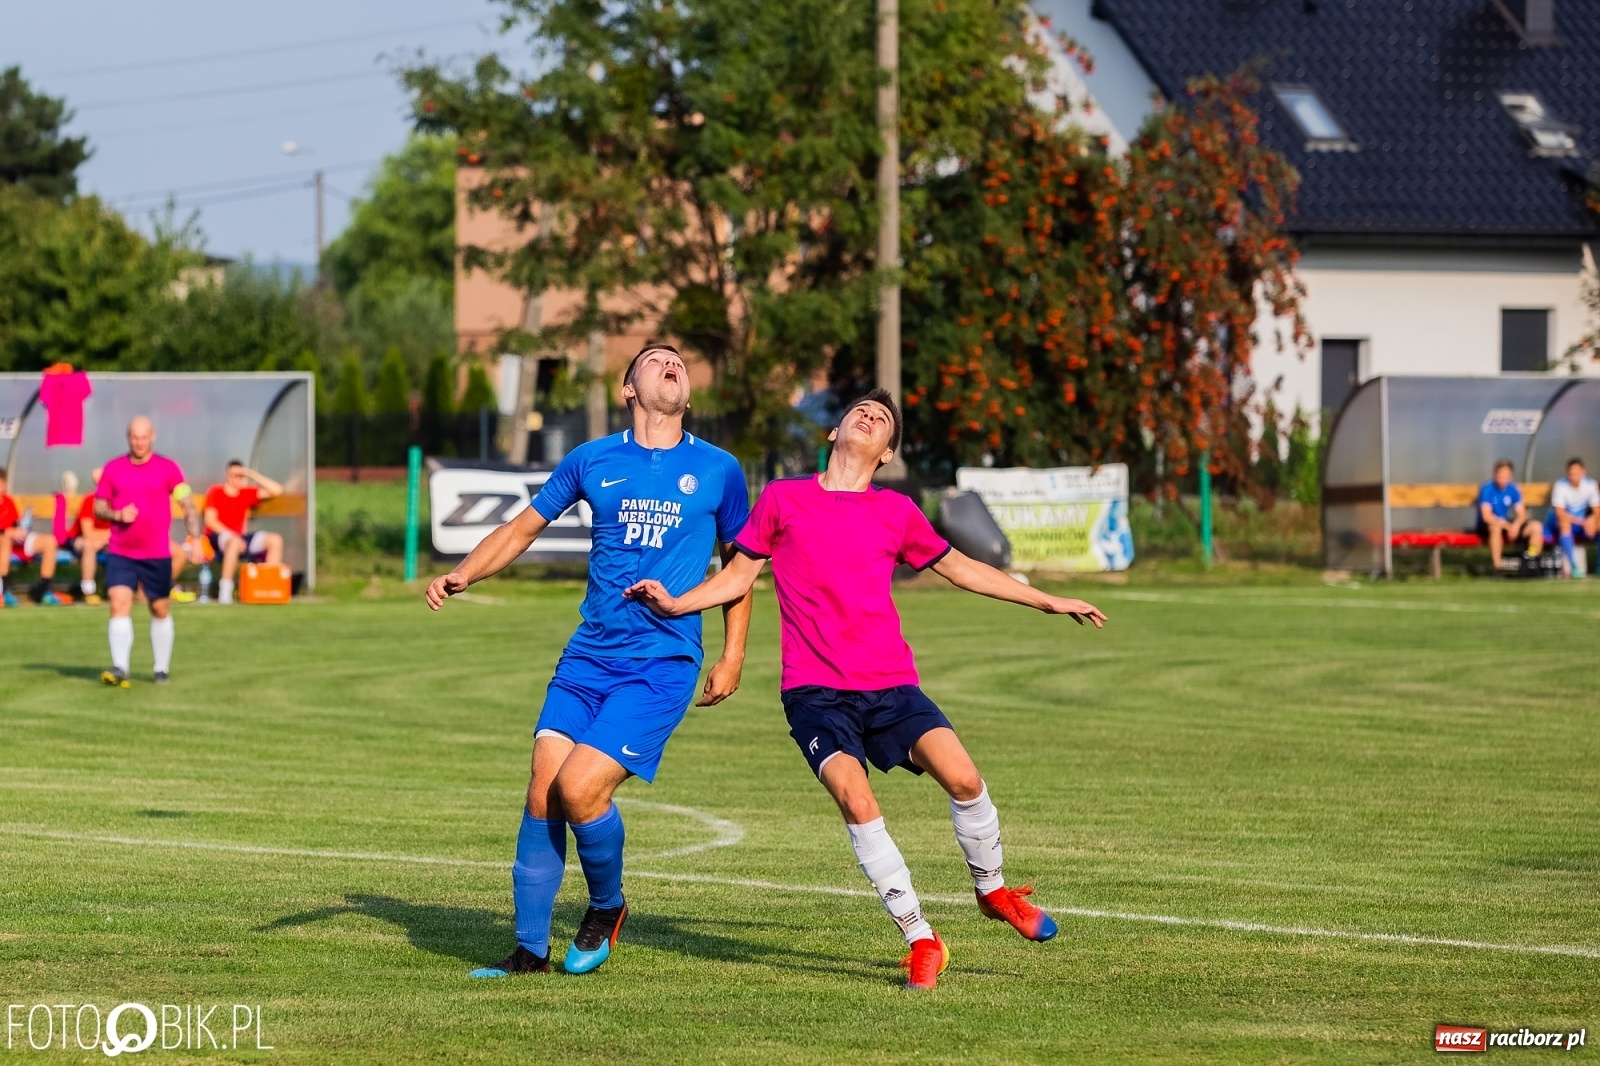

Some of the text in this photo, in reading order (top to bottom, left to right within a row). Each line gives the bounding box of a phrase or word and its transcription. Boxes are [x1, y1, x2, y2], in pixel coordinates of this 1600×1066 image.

[621, 499, 681, 515] PAWILON
[618, 511, 683, 528] MEBLOWY
[623, 522, 668, 549] PIK
